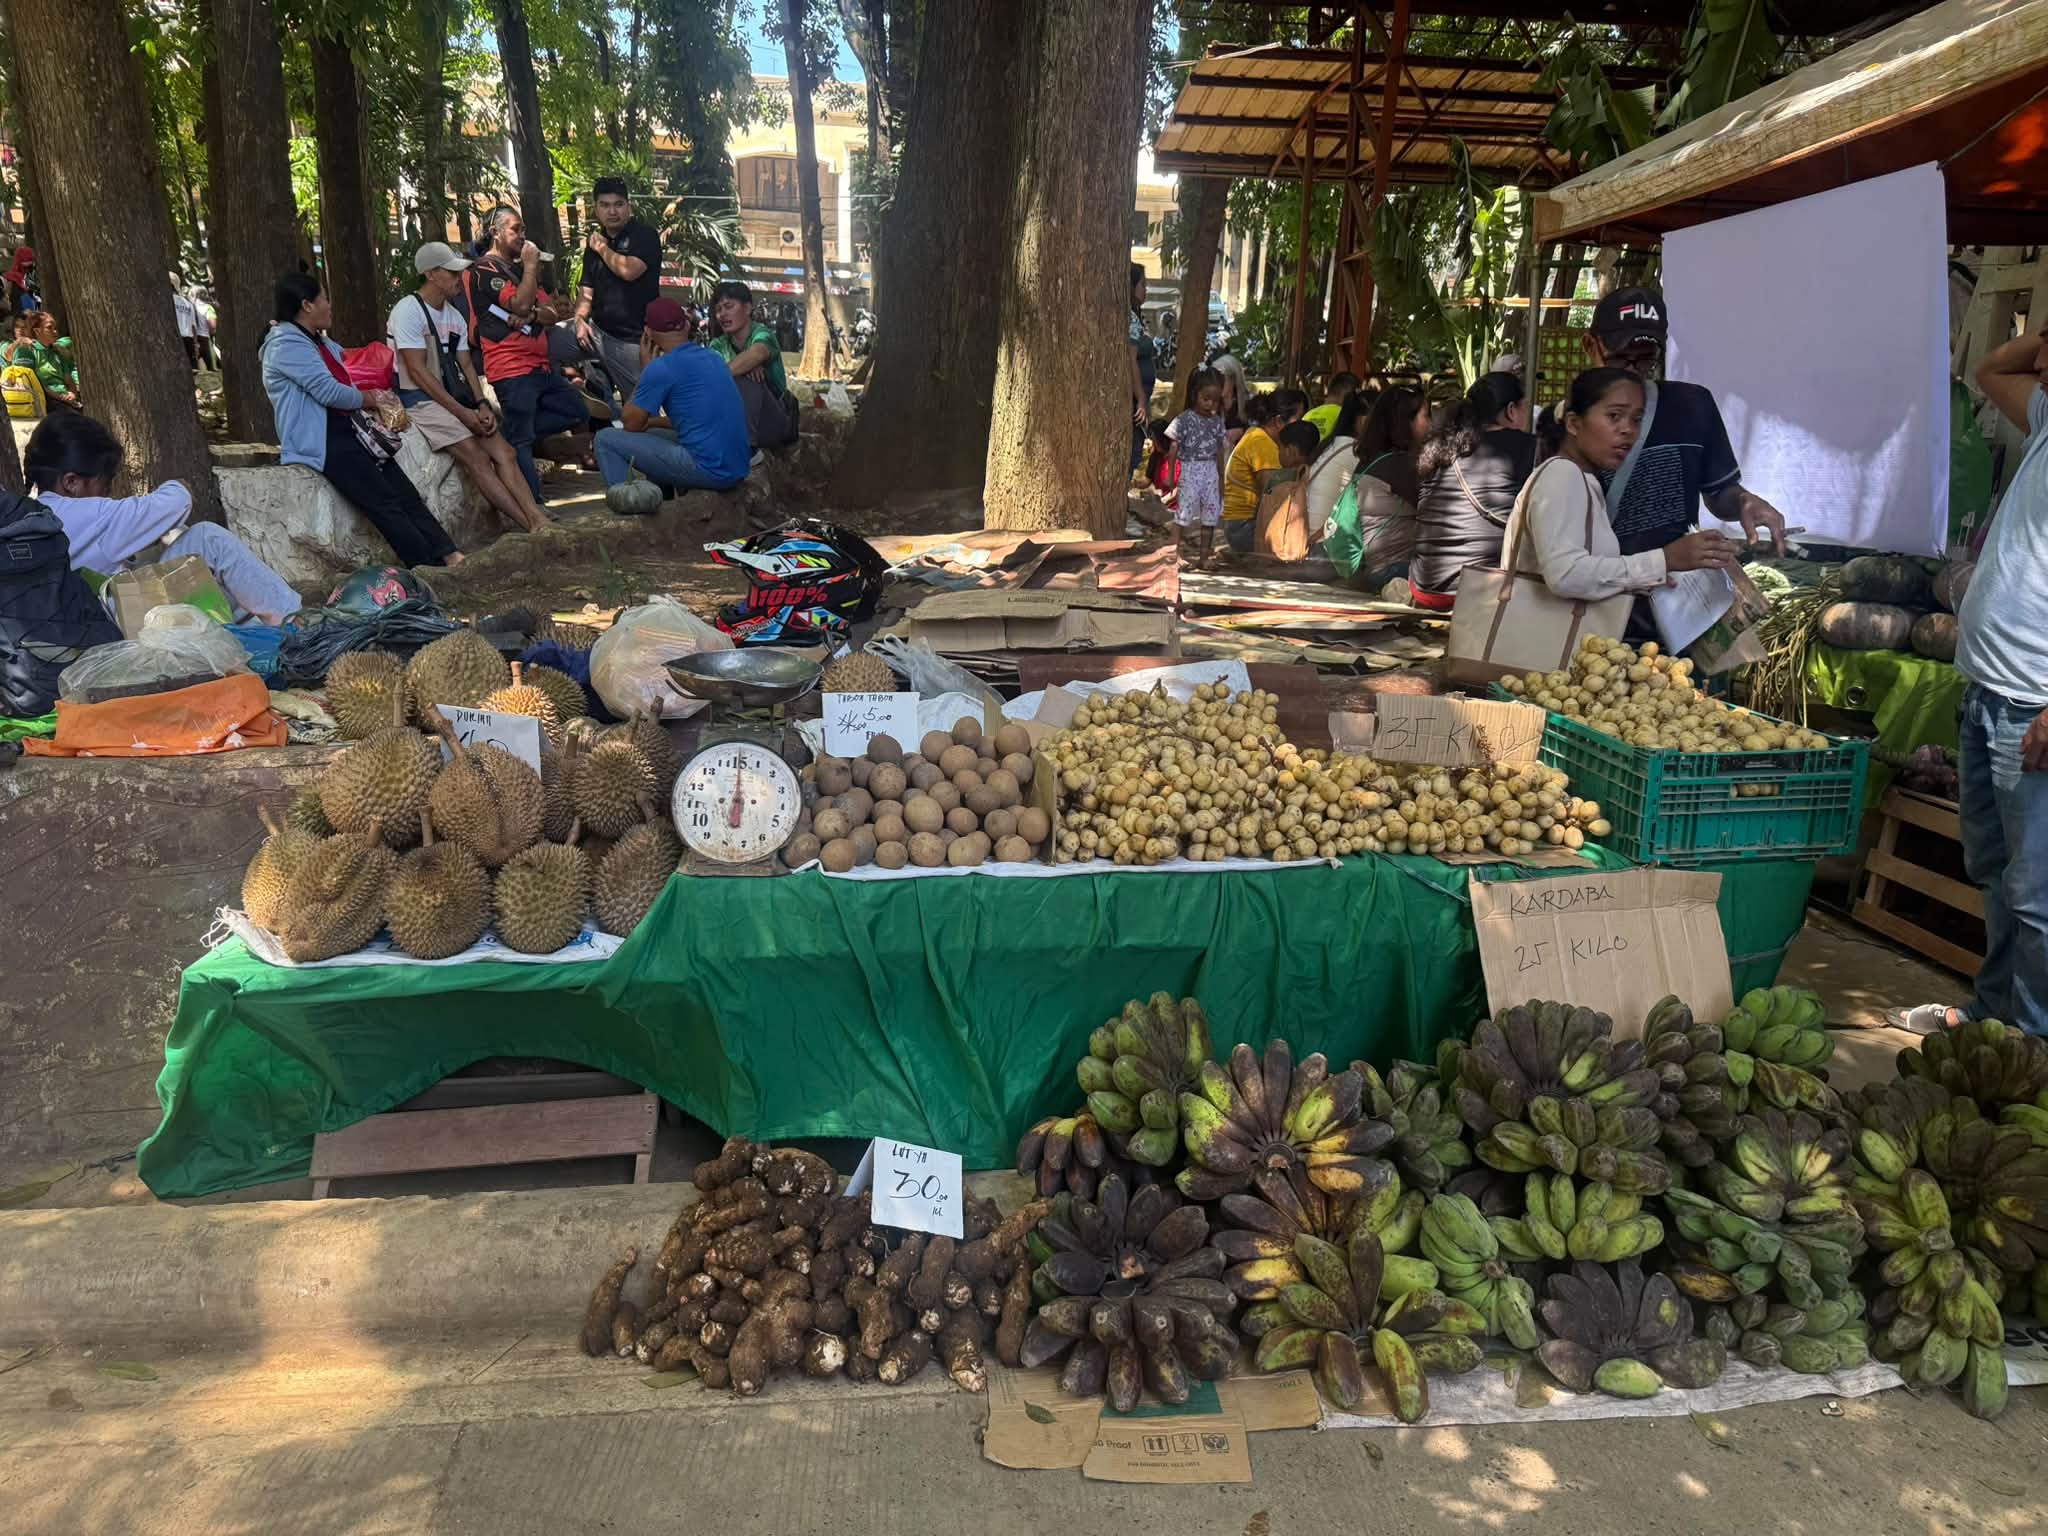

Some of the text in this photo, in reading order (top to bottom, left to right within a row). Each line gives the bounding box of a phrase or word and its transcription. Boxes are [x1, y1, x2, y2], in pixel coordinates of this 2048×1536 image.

[1618, 303, 1660, 321] FILA
[758, 585, 829, 606] 100%
[691, 813, 708, 827] 10
[1510, 885, 1616, 920] KARDABA
[1514, 935, 1628, 972] 25 KILO
